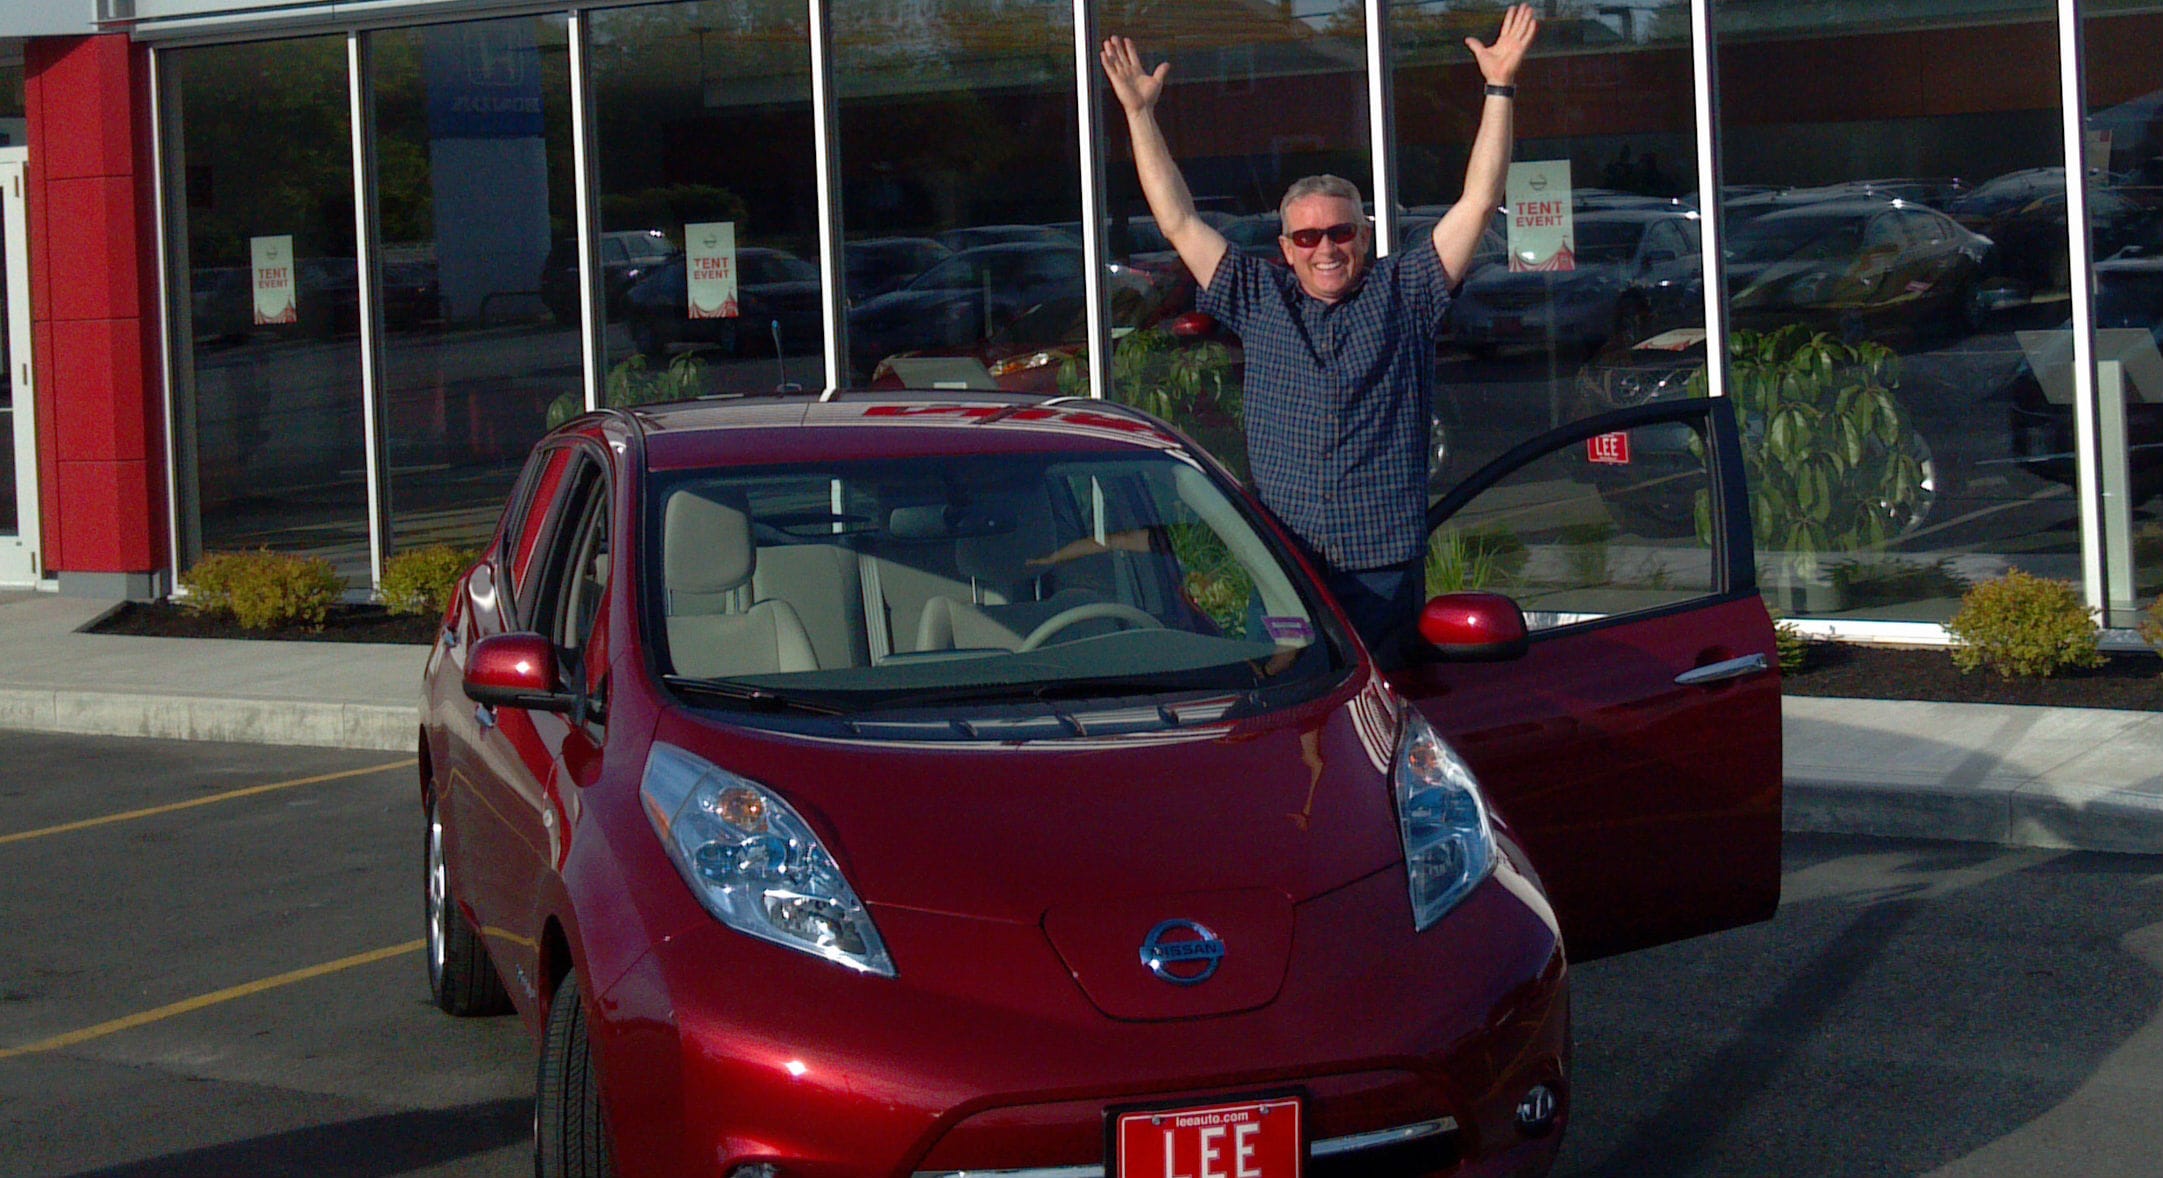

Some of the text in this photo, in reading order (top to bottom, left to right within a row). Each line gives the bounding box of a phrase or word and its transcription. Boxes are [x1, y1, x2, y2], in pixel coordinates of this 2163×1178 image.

[1516, 201, 1563, 215] TENT
[1516, 215, 1564, 228] EVENT
[694, 257, 729, 269] TENT
[258, 267, 288, 279] TENT
[694, 269, 730, 280] EVENT
[258, 280, 289, 289] EVENT
[1595, 437, 1619, 457] LEE
[1151, 943, 1217, 958] NISSAN
[1176, 1110, 1249, 1128] leeauto.com
[1163, 1122, 1261, 1178] LEE
